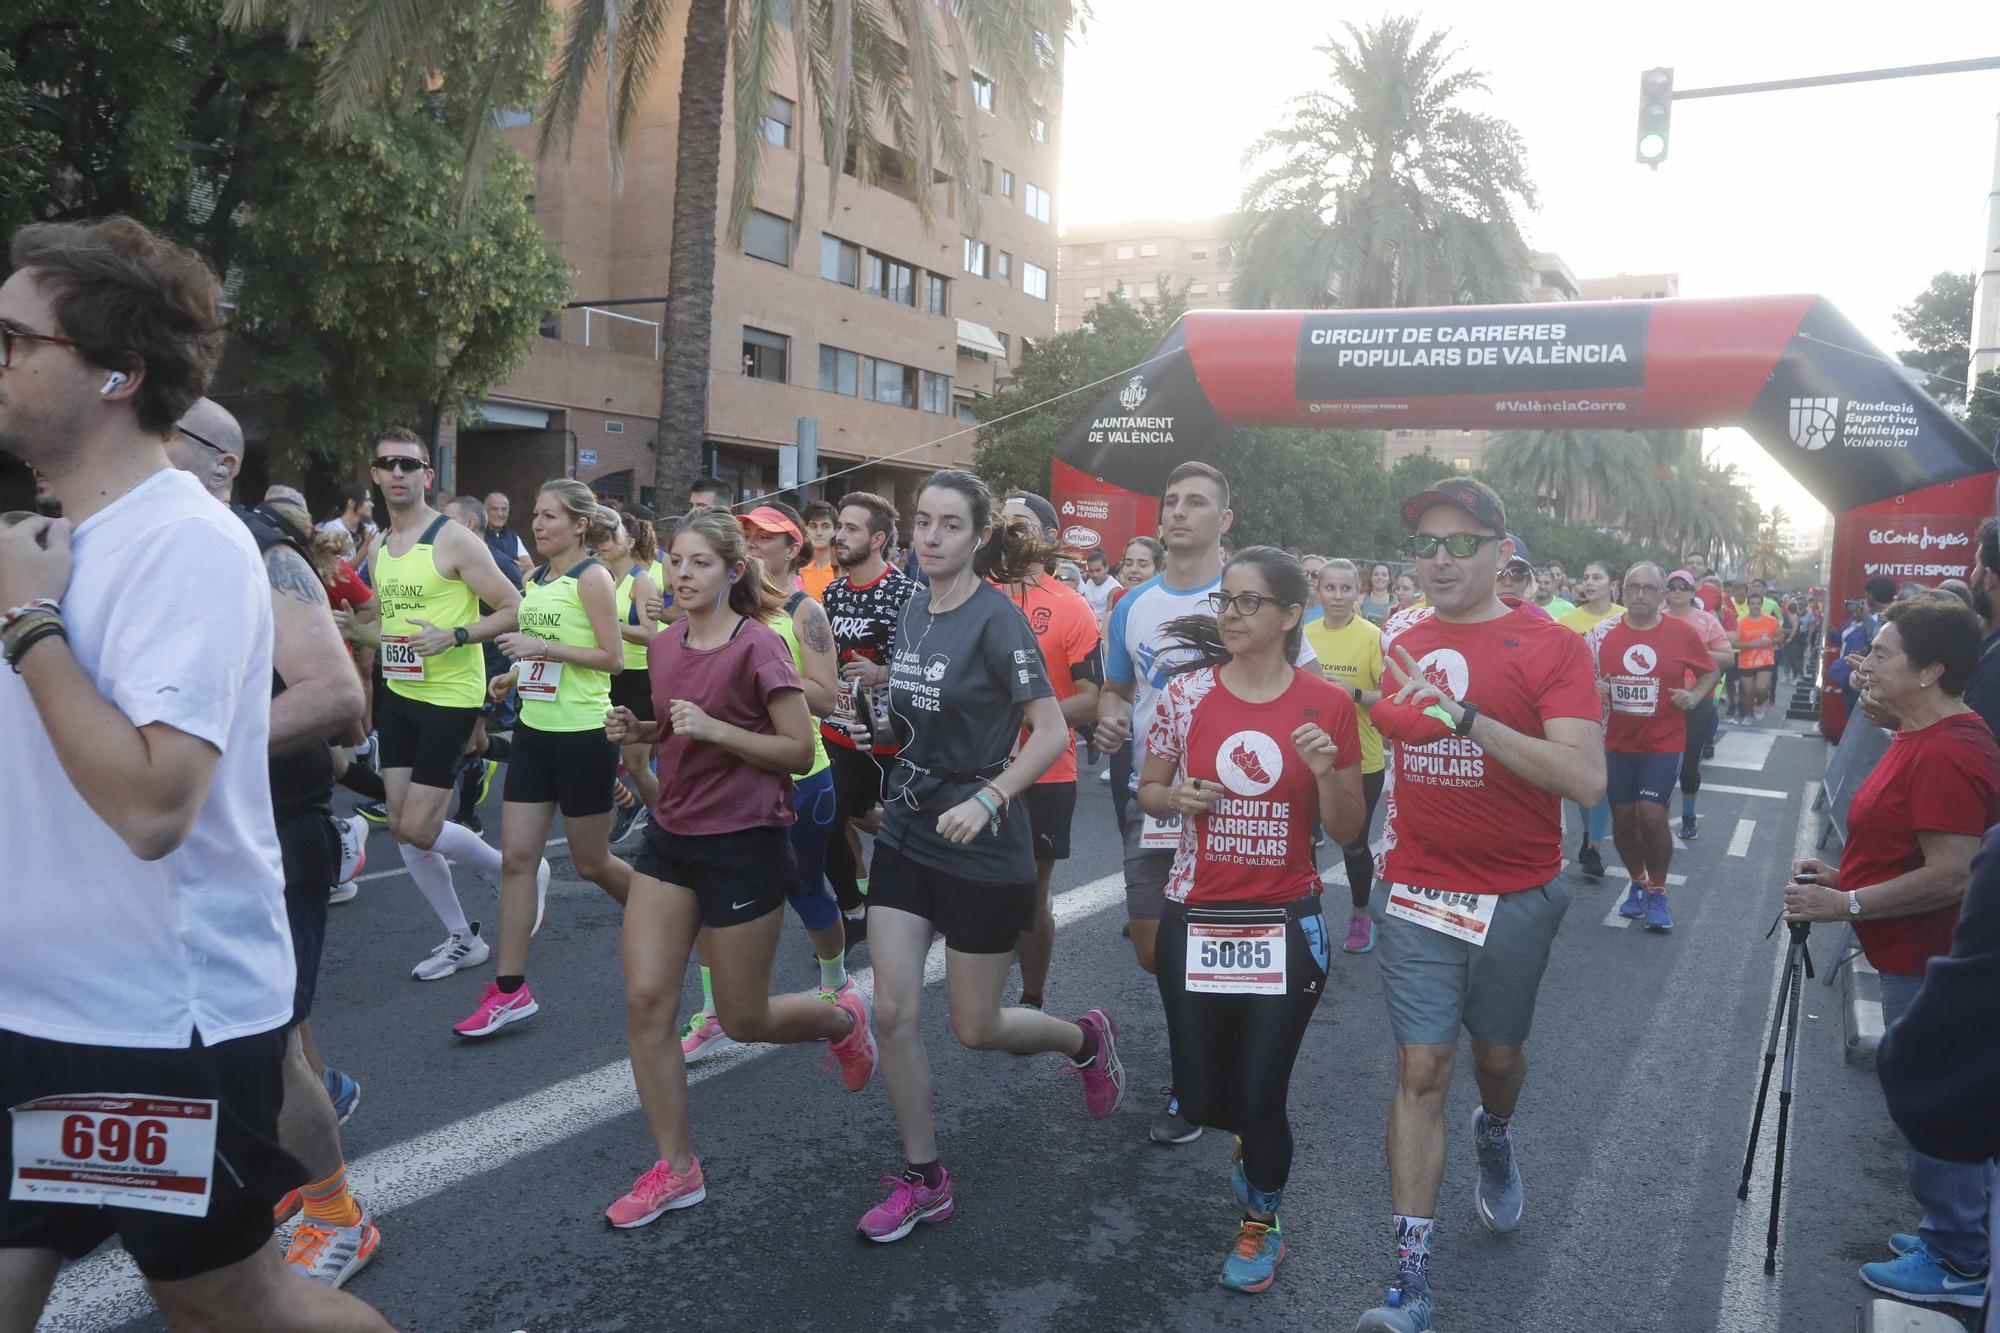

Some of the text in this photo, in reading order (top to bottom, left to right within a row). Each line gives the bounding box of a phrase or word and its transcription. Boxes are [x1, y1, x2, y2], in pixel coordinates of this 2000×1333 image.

[1310, 323, 1567, 345] CIRCUIT DE CARRERES
[1338, 341, 1627, 367] POPULARS DE VALÈNCIA
[1494, 400, 1627, 412] #ValènciaCorre
[1846, 400, 1914, 413] Fundació
[1091, 417, 1174, 429] AJUNTAMENT
[1845, 413, 1917, 426] Esportiva
[1088, 428, 1174, 443] DE VALÈNCIA
[1844, 424, 1919, 438] Municipal
[1843, 437, 1908, 448] València
[1076, 511, 1107, 519] ALFONSO
[1077, 505, 1108, 513] TRINIDAD
[1067, 531, 1096, 543] Serrano
[1869, 527, 1968, 549] El Corte Inglés
[1880, 563, 1968, 577] INTERSPORT
[400, 585, 423, 597] SANZ
[394, 602, 426, 610] SOUL
[538, 613, 561, 627] SANZ
[386, 644, 415, 663] 6528
[530, 662, 545, 681] 27
[1616, 686, 1648, 700] 5640
[912, 694, 940, 712] 2022
[1403, 753, 1484, 777] POPULARS
[1426, 777, 1437, 785] DE
[1440, 776, 1485, 788] VALÈNCIA
[1272, 802, 1290, 819] DE
[1208, 815, 1288, 838] CARRERES
[1206, 833, 1288, 856] POPULARS
[1204, 852, 1286, 867] CIUTAT DE VALÈNCIA
[1201, 940, 1271, 968] 5085
[61, 1114, 168, 1165] 696
